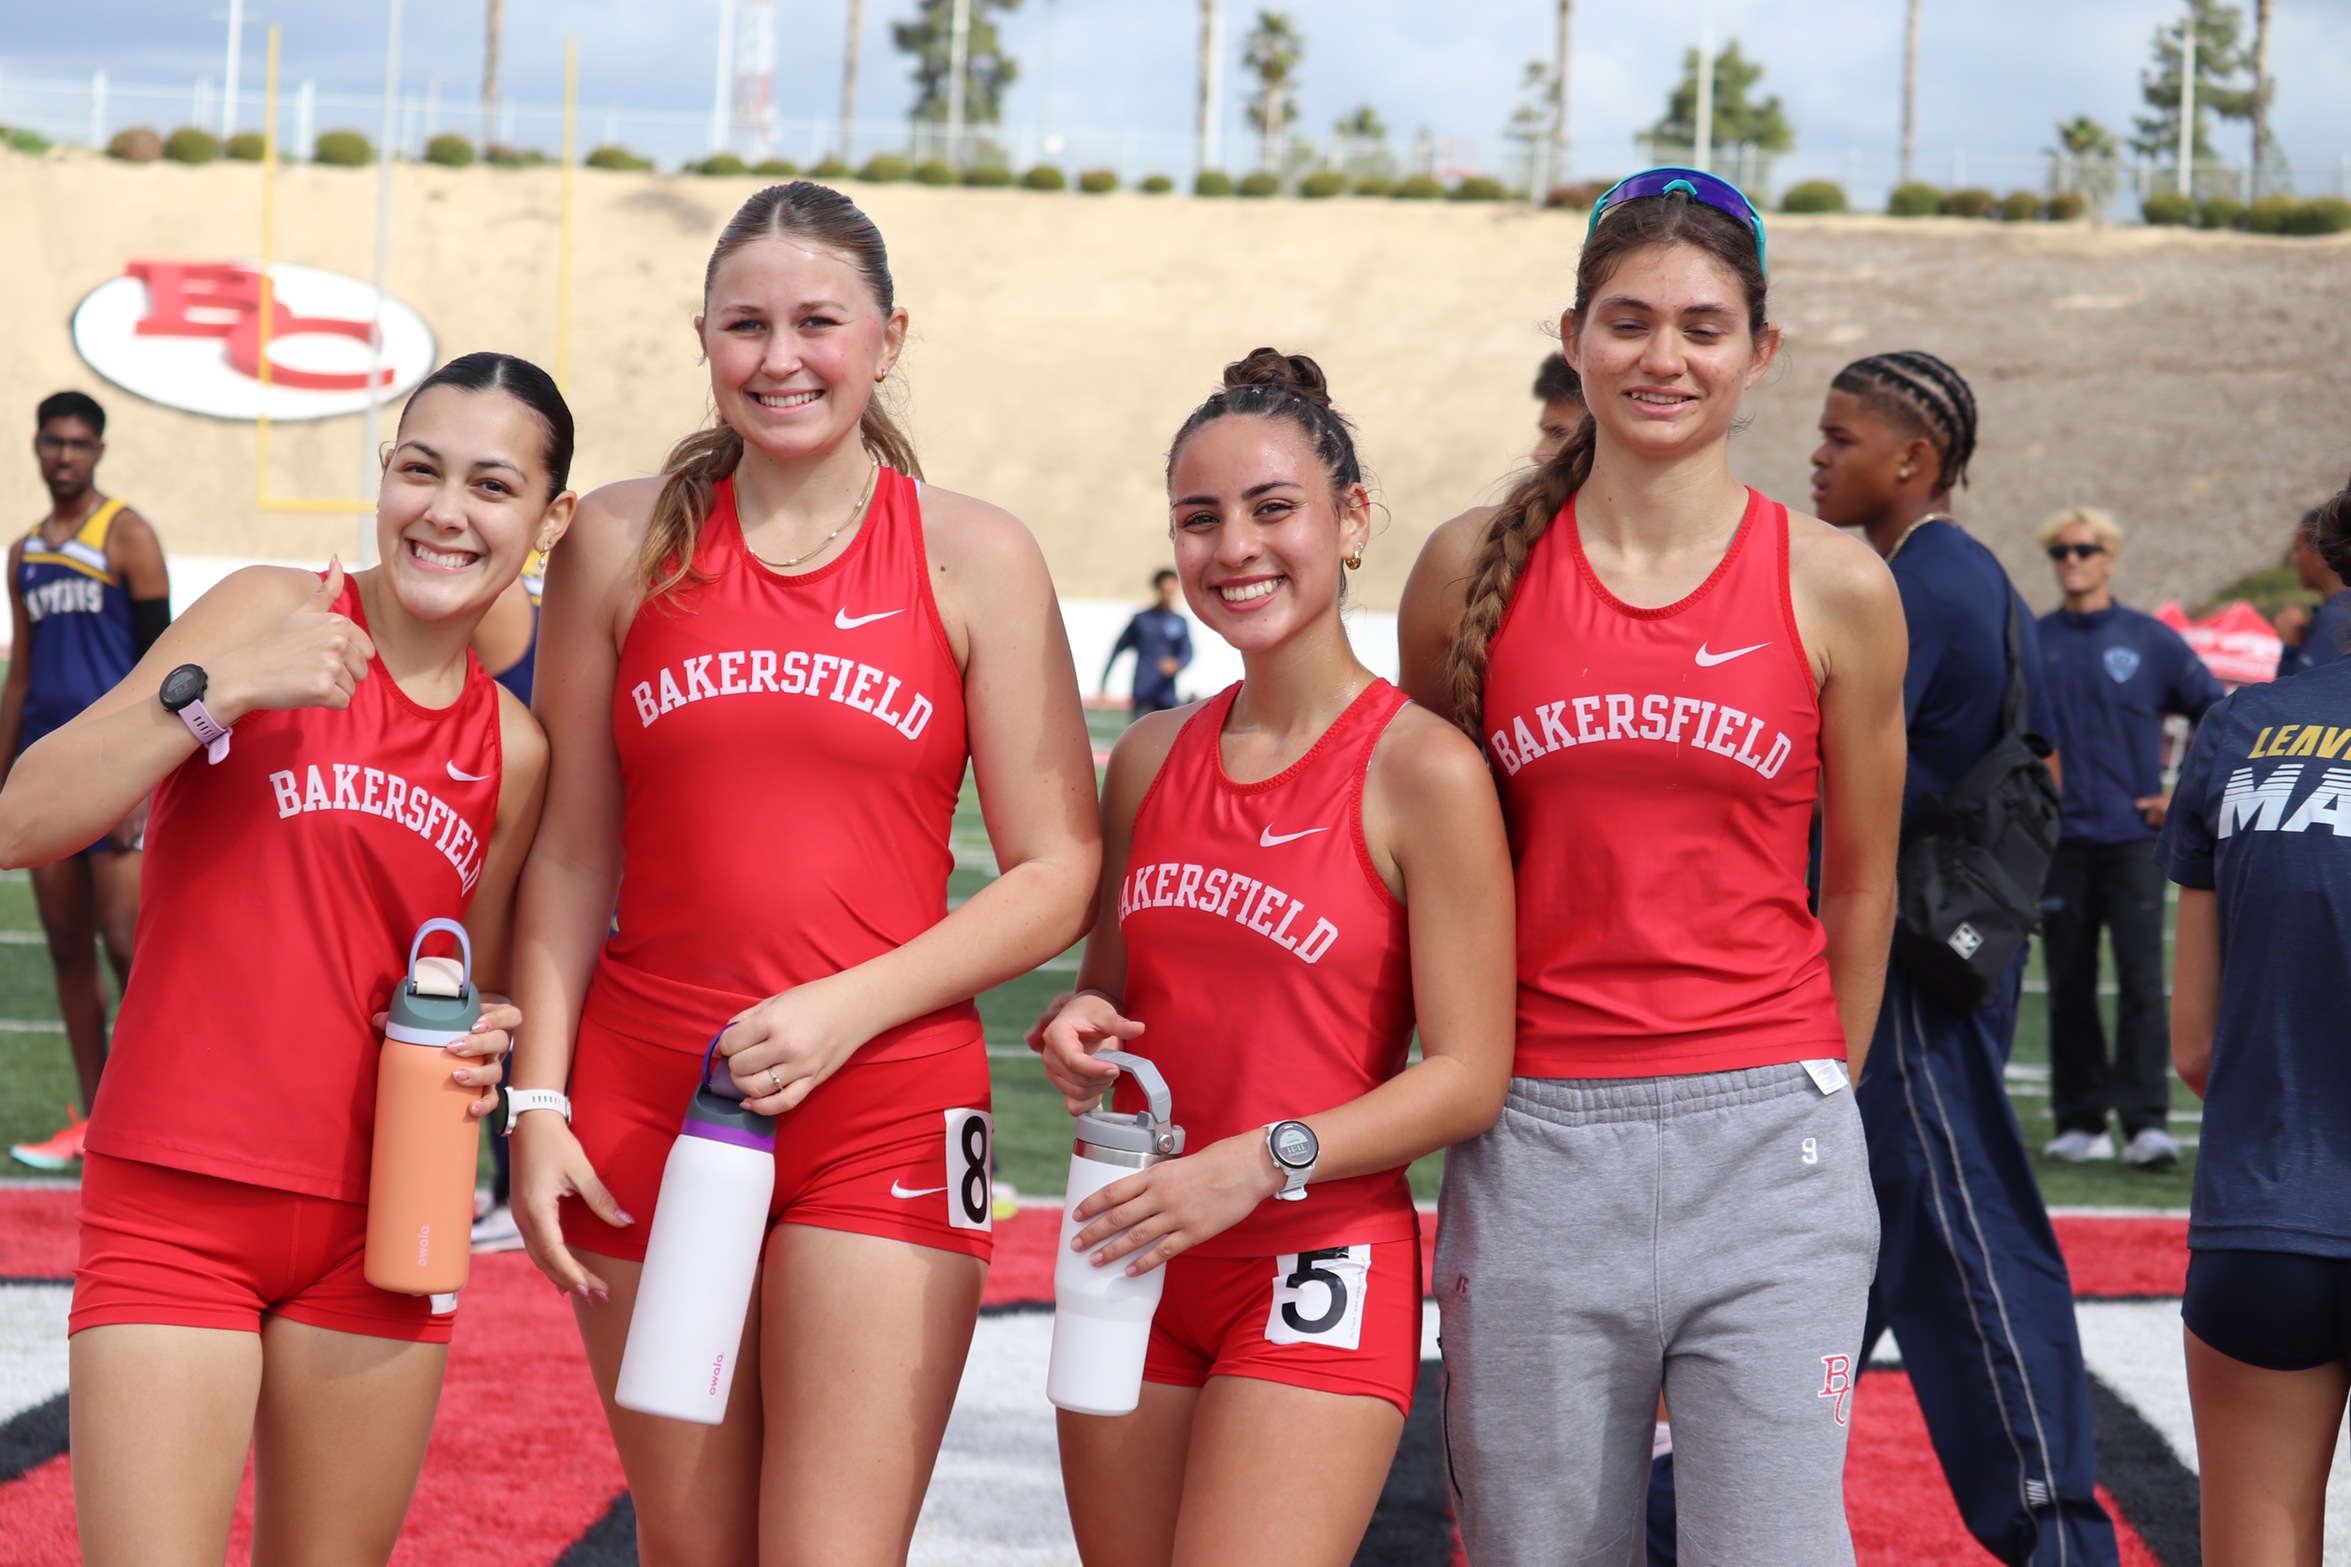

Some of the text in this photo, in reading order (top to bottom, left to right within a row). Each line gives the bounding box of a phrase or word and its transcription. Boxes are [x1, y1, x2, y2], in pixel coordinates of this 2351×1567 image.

[126, 259, 396, 391] BC
[632, 650, 933, 741] BAKERSFIELD
[1490, 693, 1792, 780] BAKERSFIELD
[269, 763, 482, 898] BAKERSFIELD
[1118, 862, 1339, 965] AKERSFIELD
[961, 1115, 987, 1224] 8
[1802, 1137, 1818, 1164] 9
[418, 1225, 430, 1268] owala
[1281, 1246, 1349, 1334] 5
[709, 1354, 724, 1396] owala
[2025, 1479, 2049, 1507] NIK
